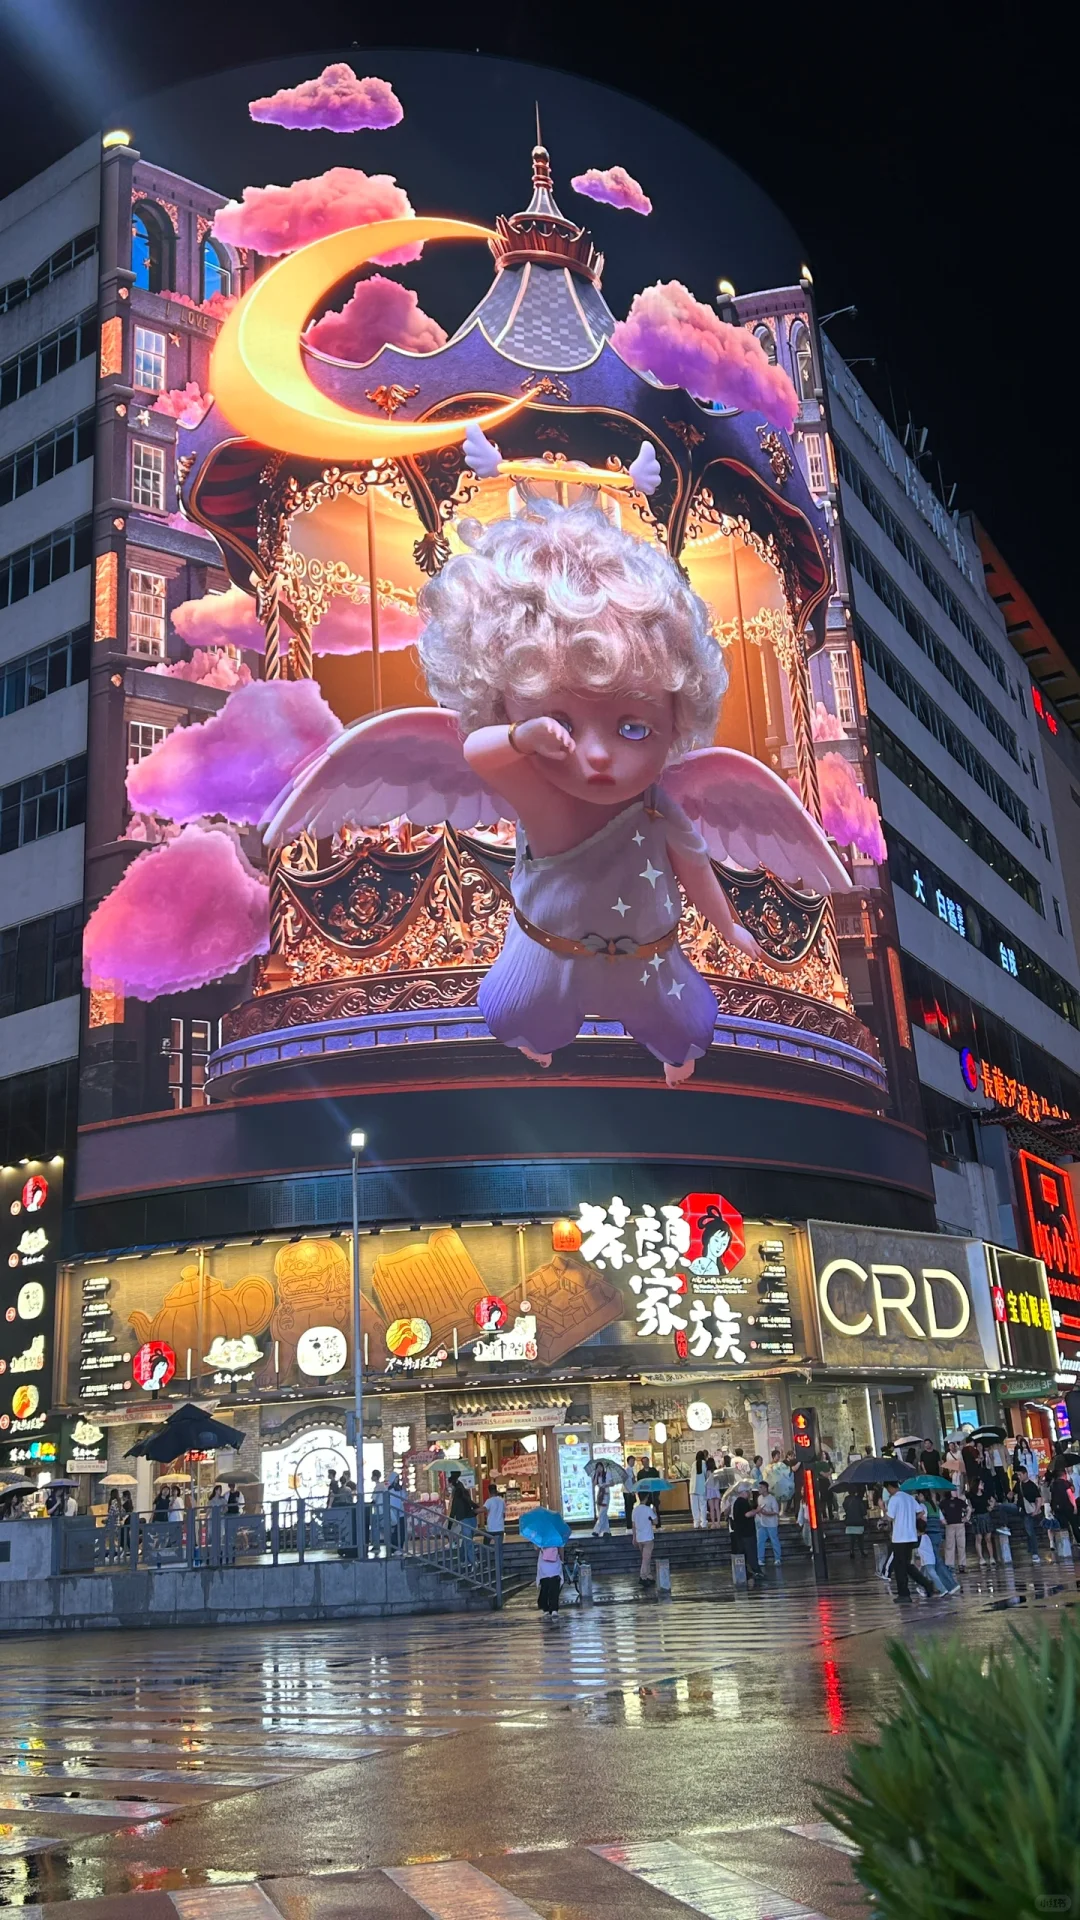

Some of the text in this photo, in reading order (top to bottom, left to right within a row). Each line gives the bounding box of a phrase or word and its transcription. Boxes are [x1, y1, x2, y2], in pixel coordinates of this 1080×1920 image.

[181, 308, 209, 330] LOVE
[819, 1258, 970, 1338] CRD
[1041, 1380, 1052, 1390] 3F
[797, 1434, 810, 1447] 46
